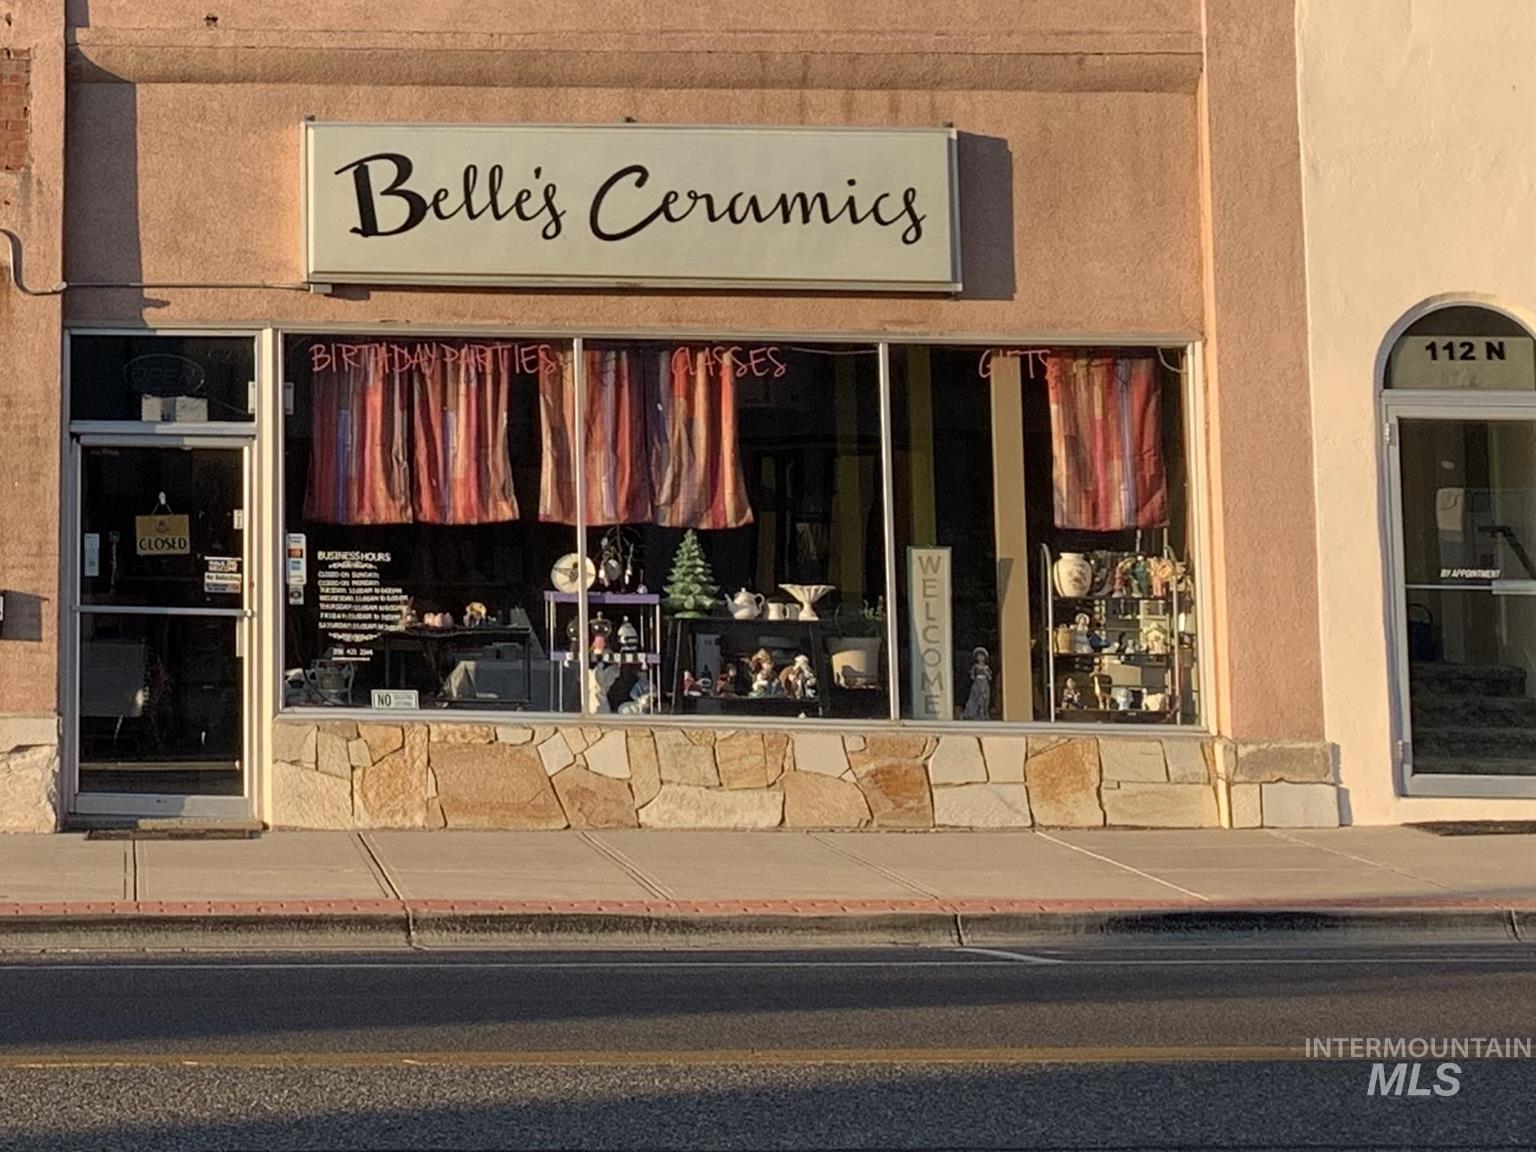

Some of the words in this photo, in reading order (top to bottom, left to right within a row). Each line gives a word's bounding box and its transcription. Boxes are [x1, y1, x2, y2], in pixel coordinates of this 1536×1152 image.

[334, 152, 567, 240] Belle's
[589, 163, 927, 245] Ceramics
[309, 342, 437, 375] BIRTHDAY
[440, 342, 557, 375] PARTIES
[671, 346, 787, 378] CLASSES
[1425, 341, 1476, 361] 112
[1485, 341, 1506, 361] N
[139, 537, 188, 551] CLOSED
[317, 550, 361, 561] BUSINESS
[361, 552, 392, 563] HOURS
[918, 555, 944, 715] WELCOME
[377, 693, 392, 707] NO
